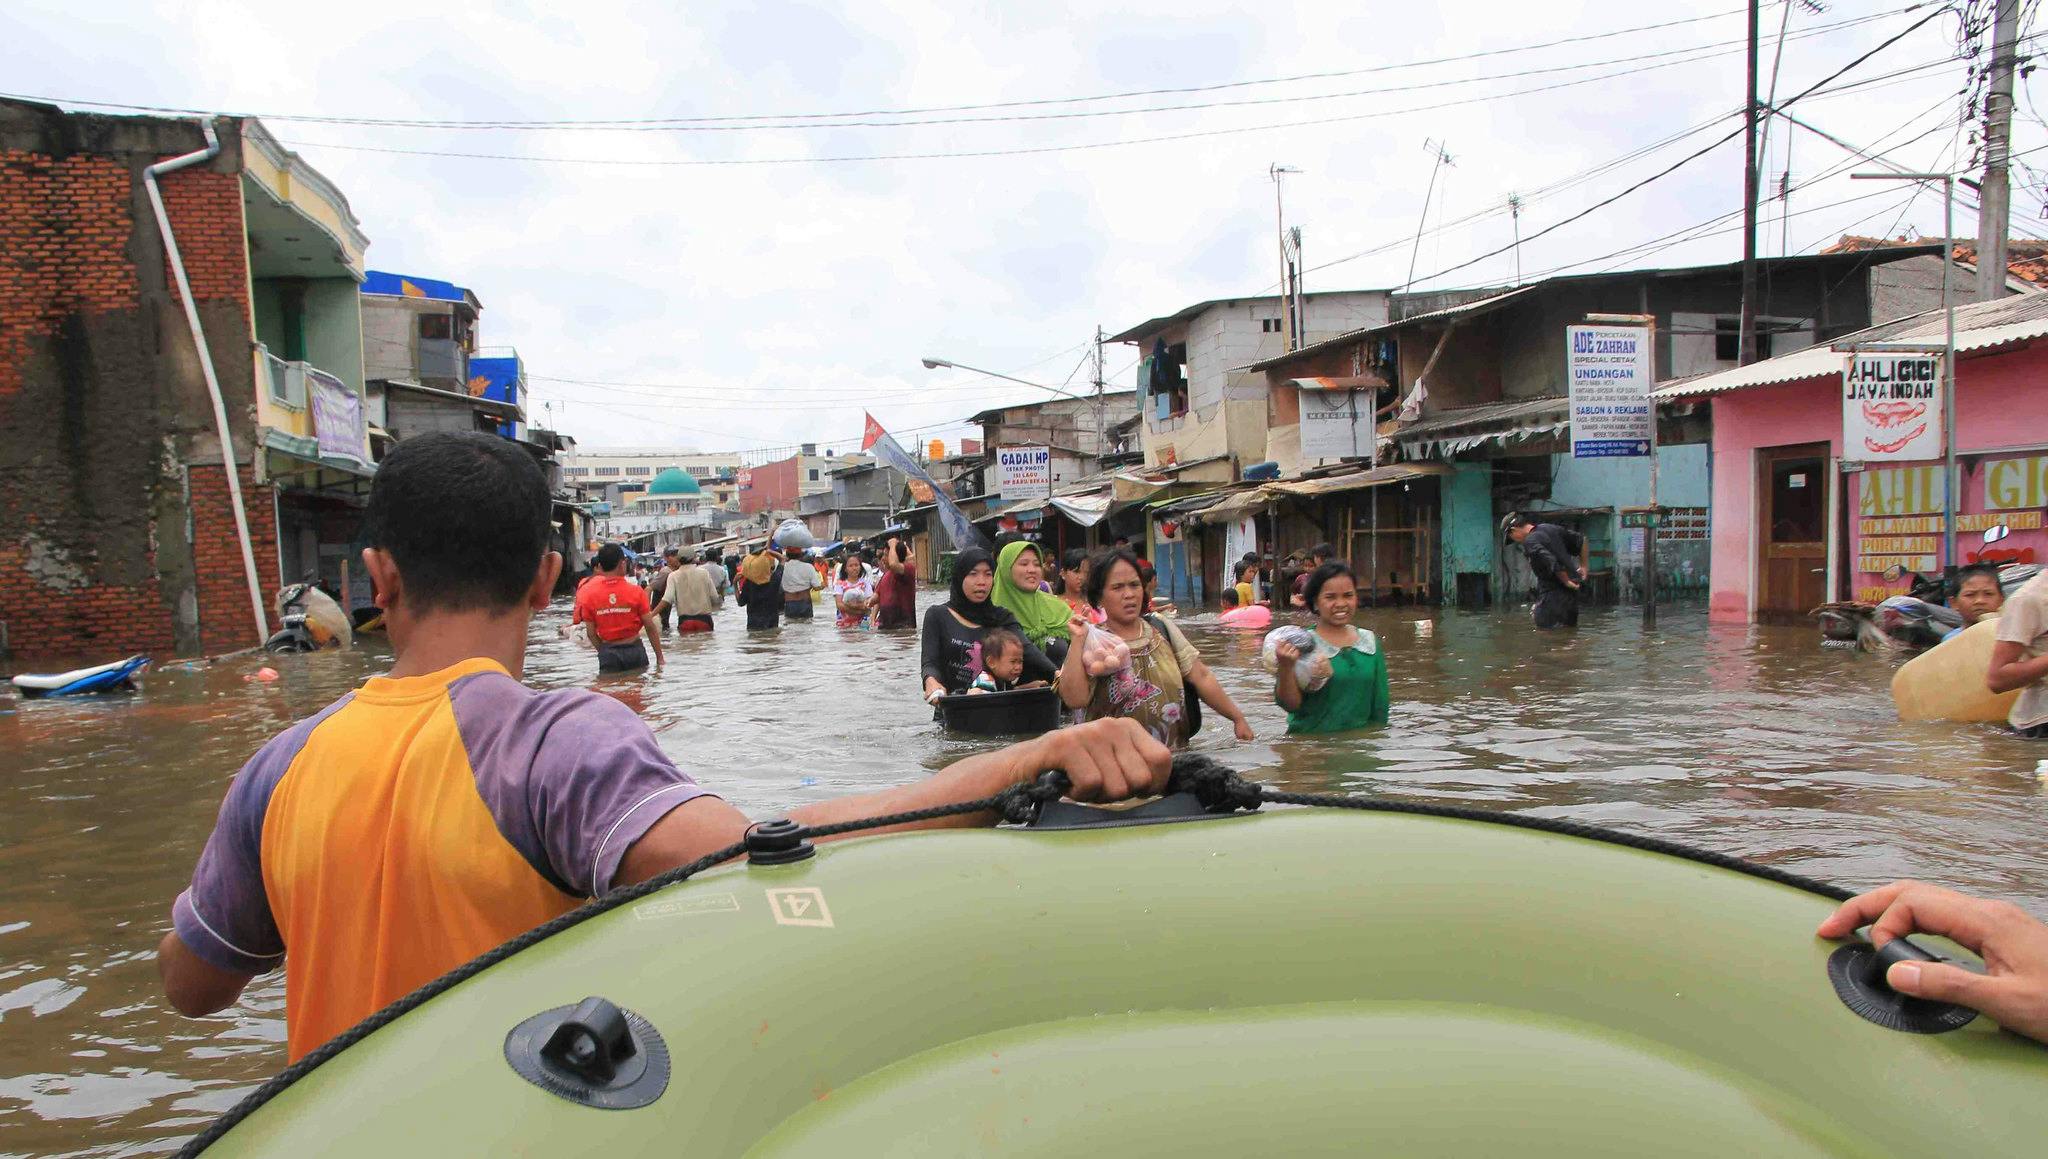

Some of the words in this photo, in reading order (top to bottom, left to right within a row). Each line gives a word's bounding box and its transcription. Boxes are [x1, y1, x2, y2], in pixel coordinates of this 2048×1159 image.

[1574, 332, 1594, 353] ADE
[1596, 340, 1636, 353] ZAHRAN
[1575, 369, 1634, 379] UNDANGAN
[1847, 360, 1895, 382] AHLI
[1847, 384, 1889, 400] JAYA
[1890, 383, 1933, 399] INDAH
[1575, 406, 1605, 414] SABLON
[1607, 406, 1612, 414] &
[1614, 405, 1649, 414] REKLAME
[1001, 452, 1033, 465] GADAI
[1035, 452, 1048, 464] HP
[1860, 467, 1944, 515] AHL
[1989, 457, 2048, 509] GI
